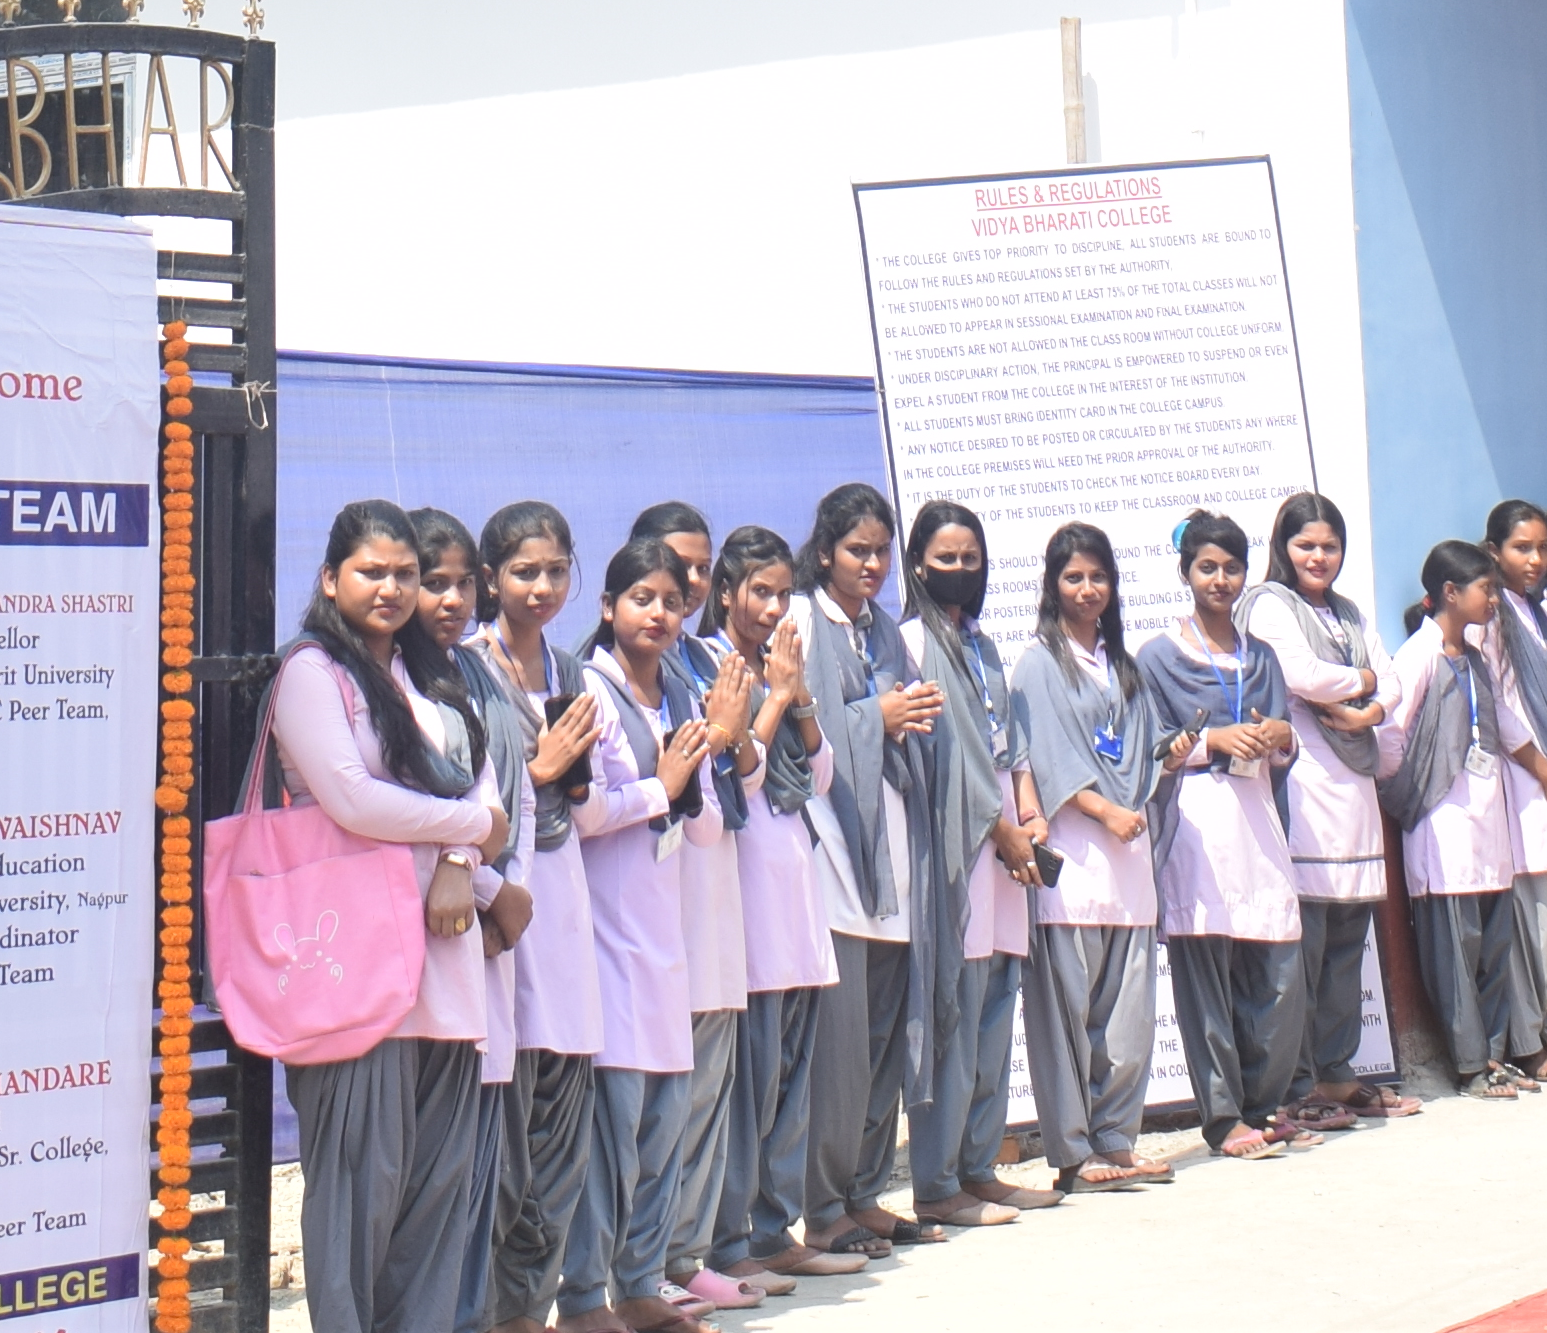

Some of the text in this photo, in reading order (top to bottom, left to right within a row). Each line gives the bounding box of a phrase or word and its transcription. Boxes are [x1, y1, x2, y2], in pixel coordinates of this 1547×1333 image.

[973, 176, 1162, 208] RULES & REGULATIONS
[970, 204, 1172, 237] VIDYA BHARATI COLLEGE
[881, 254, 901, 268] THE
[902, 251, 947, 266] COLLEGE
[951, 249, 981, 263] GIVES
[982, 247, 1002, 260] TOP
[1005, 244, 1050, 259] PRIORITY
[1053, 242, 1067, 255] TO
[1128, 237, 1147, 250] ALL
[1148, 233, 1197, 249] STUDENTS
[1200, 232, 1220, 245] ARE
[1223, 229, 1257, 243] BOUND
[1258, 228, 1272, 241] TO
[877, 276, 919, 291] FOLLOW
[920, 275, 939, 288] THE
[940, 273, 974, 287] RULES
[974, 271, 996, 285] AND
[996, 266, 1063, 283] REGULATIONS
[1063, 265, 1082, 278] SET
[1083, 264, 1097, 277] BY
[1098, 262, 1117, 276] THE
[887, 274, 1277, 315] THE STUDENTS WHO DO NOT ATTEND AT LEAST 75% OF THE TOTAL CLASSES WILL NOT
[902, 419, 922, 432] ALL
[922, 415, 974, 431] STUDENTS
[974, 412, 1003, 427] MUST
[1003, 410, 1035, 424] BRING
[1034, 407, 1078, 422] IDENTITY
[1078, 404, 1106, 419] CARD
[1106, 403, 1118, 416] IN
[1117, 402, 1138, 416] THE
[1138, 398, 1183, 414] COLLEGE
[911, 490, 922, 504] IT
[922, 489, 933, 503] IS
[933, 488, 954, 502] THE
[954, 486, 982, 500] DUTY
[981, 484, 997, 498] OF
[997, 483, 1018, 497] THE
[1018, 479, 1069, 495] STUDENTS
[1069, 477, 1084, 491] TO
[1084, 475, 1118, 490] CHECK
[1118, 473, 1138, 487] THE
[1139, 470, 1175, 485] NOTICE
[1175, 467, 1210, 482] BOARD
[1209, 465, 1241, 480] EVERY
[998, 543, 1162, 569] SHOULD THE
[1001, 579, 1038, 594] ROOMS
[1127, 590, 1183, 607] BUILDING IS
[61, 593, 134, 614] SHASTRI
[1005, 616, 1170, 642] ARE MOBILE
[24, 663, 115, 689] University
[9, 700, 50, 721] Peer
[56, 698, 109, 721] Team,
[77, 891, 129, 911] Nagpur
[1158, 1038, 1179, 1054] THE
[30, 1135, 109, 1163] College,
[32, 1209, 87, 1234] Team
